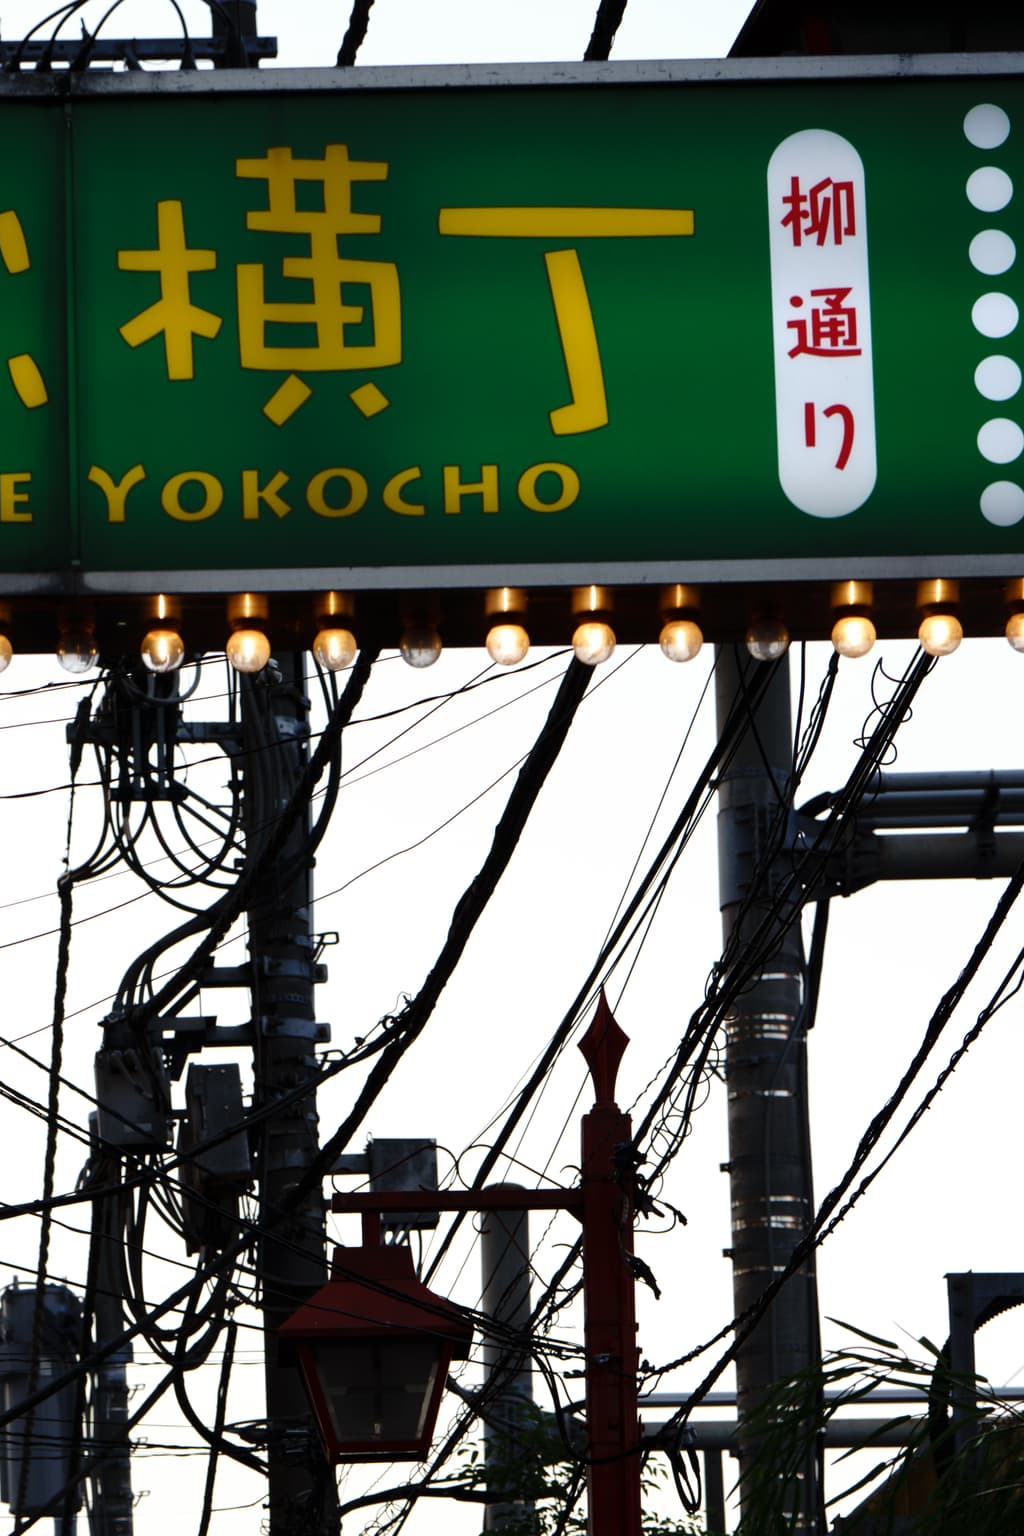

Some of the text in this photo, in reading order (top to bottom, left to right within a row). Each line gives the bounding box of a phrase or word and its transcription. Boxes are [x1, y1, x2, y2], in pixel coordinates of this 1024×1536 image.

[780, 175, 863, 471] 柳通り
[87, 460, 581, 523] YOKOCHO
